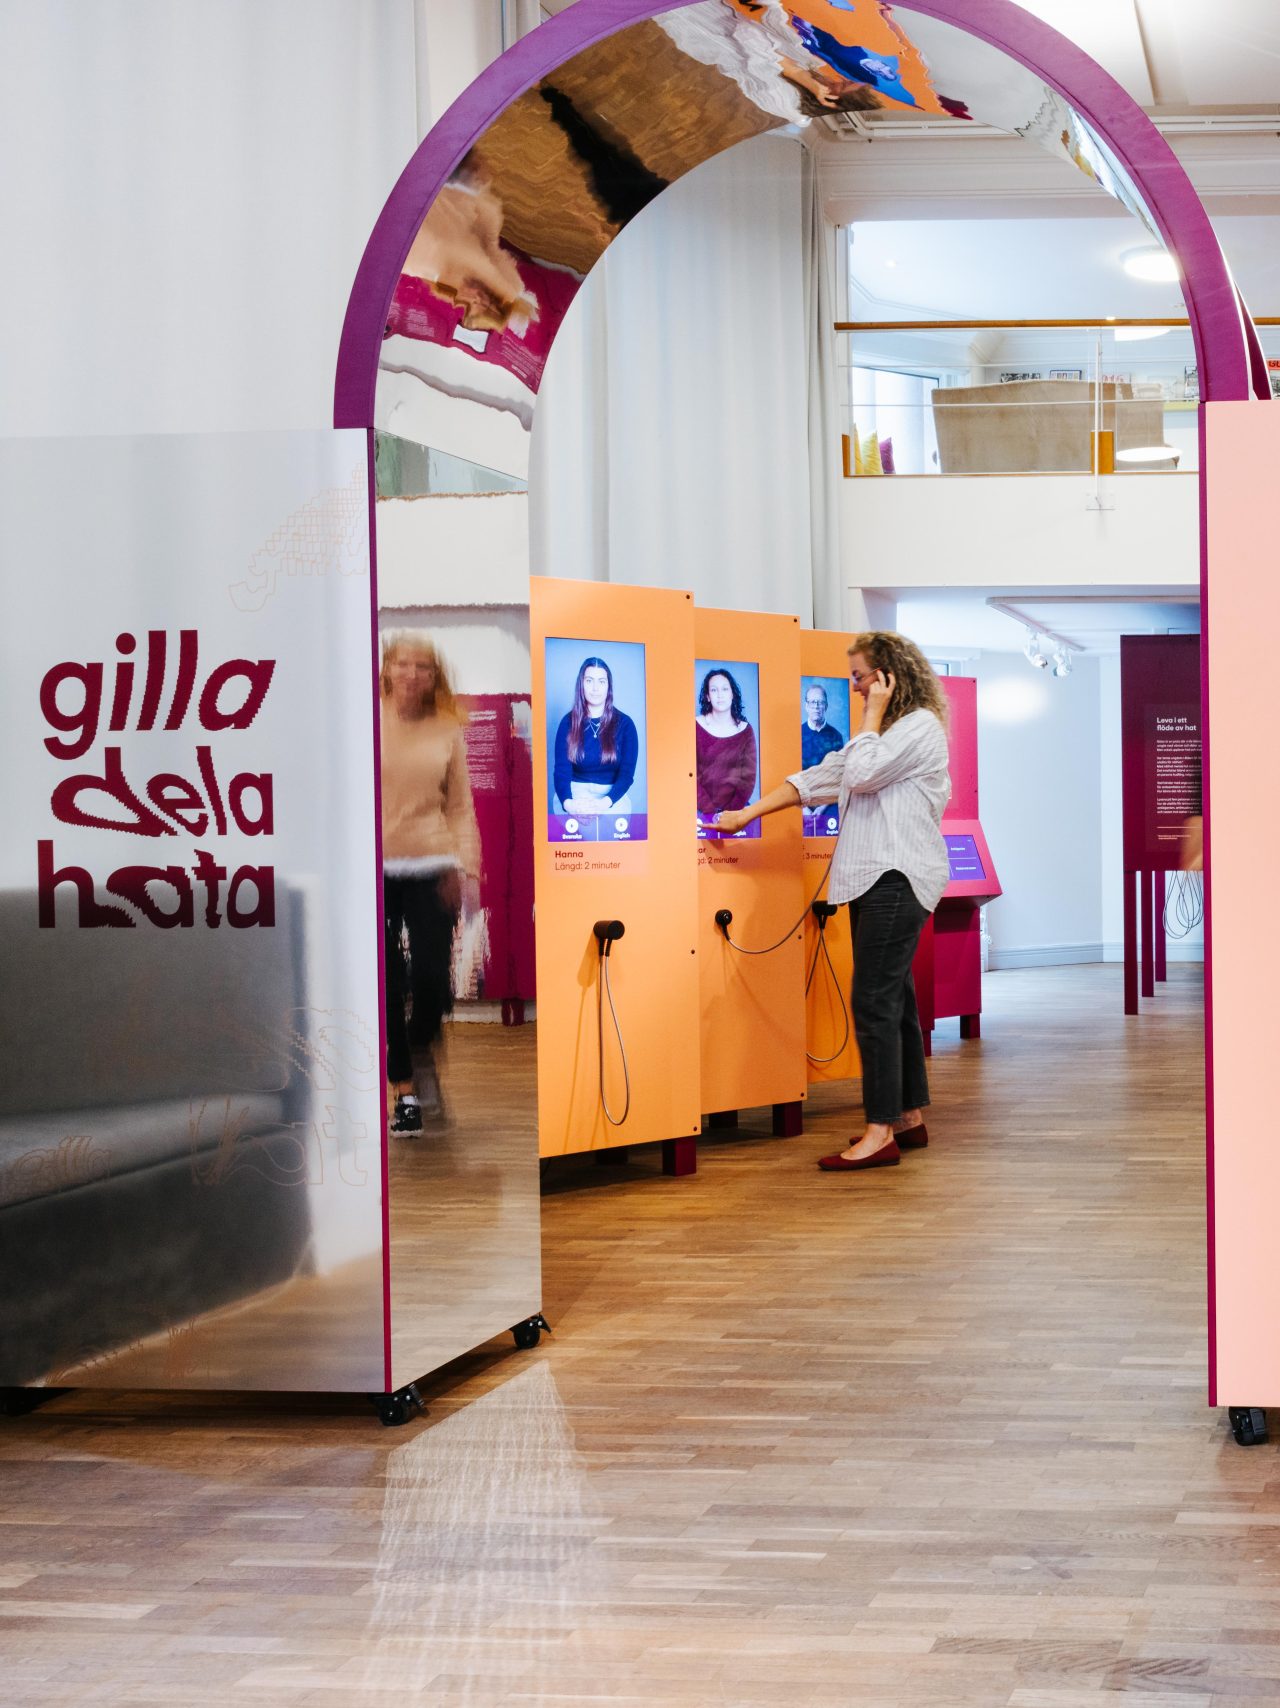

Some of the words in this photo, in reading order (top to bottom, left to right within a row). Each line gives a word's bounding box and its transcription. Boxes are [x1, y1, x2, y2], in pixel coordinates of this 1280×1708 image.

[39, 630, 277, 761] gilla
[50, 745, 275, 838] dela
[555, 850, 584, 859] Hanna
[555, 861, 583, 873] Längd:
[584, 862, 590, 870] 2
[591, 861, 621, 870] minuter
[714, 856, 739, 864] minuter
[37, 839, 276, 929] hata
